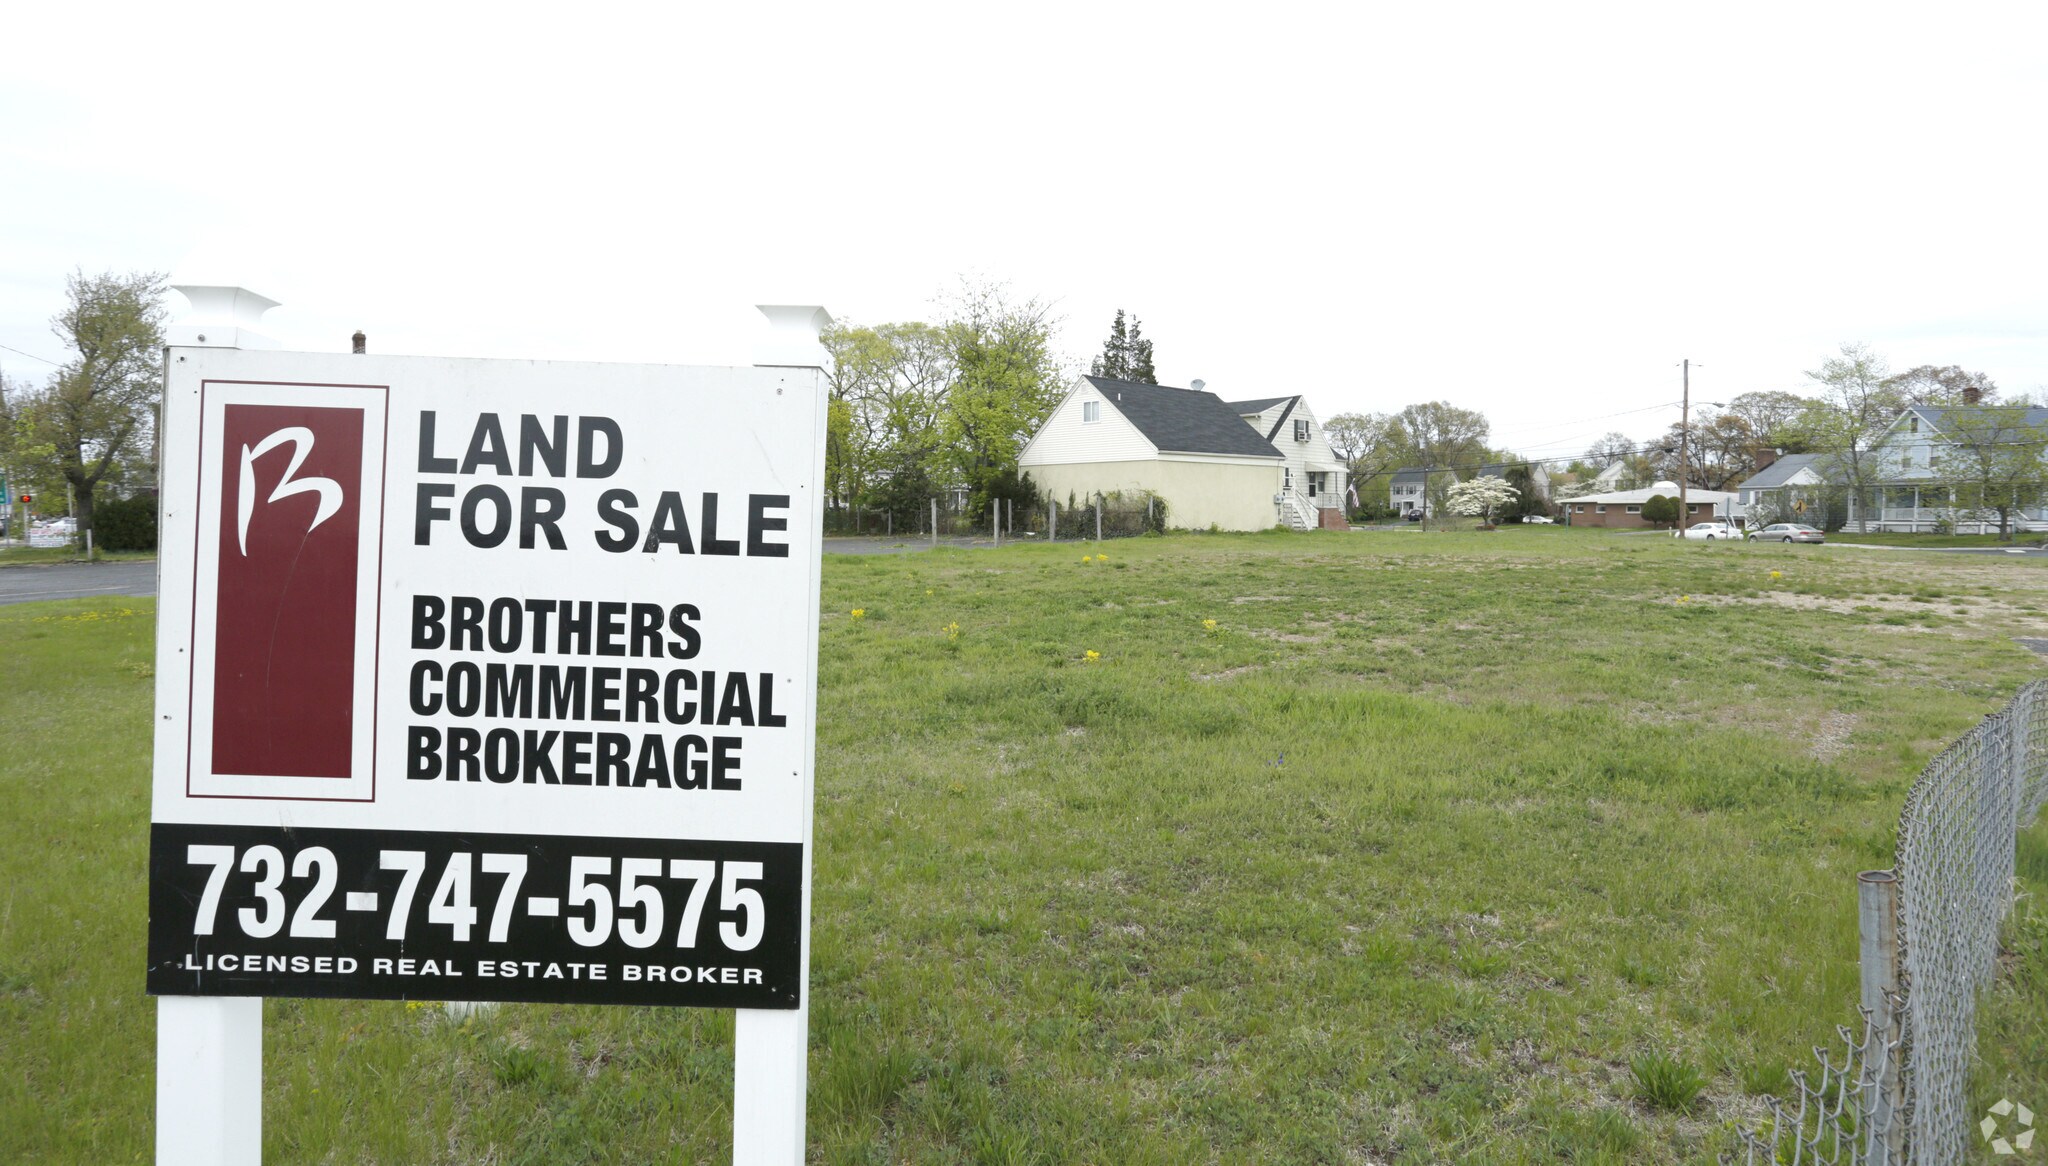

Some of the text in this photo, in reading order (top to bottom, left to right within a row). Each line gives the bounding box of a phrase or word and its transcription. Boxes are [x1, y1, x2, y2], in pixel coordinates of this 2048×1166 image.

[418, 411, 623, 478] LAND
[415, 483, 789, 557] FOR SALE
[412, 595, 701, 659] BROTHERS
[410, 660, 786, 727] COMMERCIAL
[407, 726, 742, 790] BROKERAGE
[187, 845, 764, 951] 732-747-5575
[186, 954, 762, 984] LICENSED REAL ESTATE BROKER
